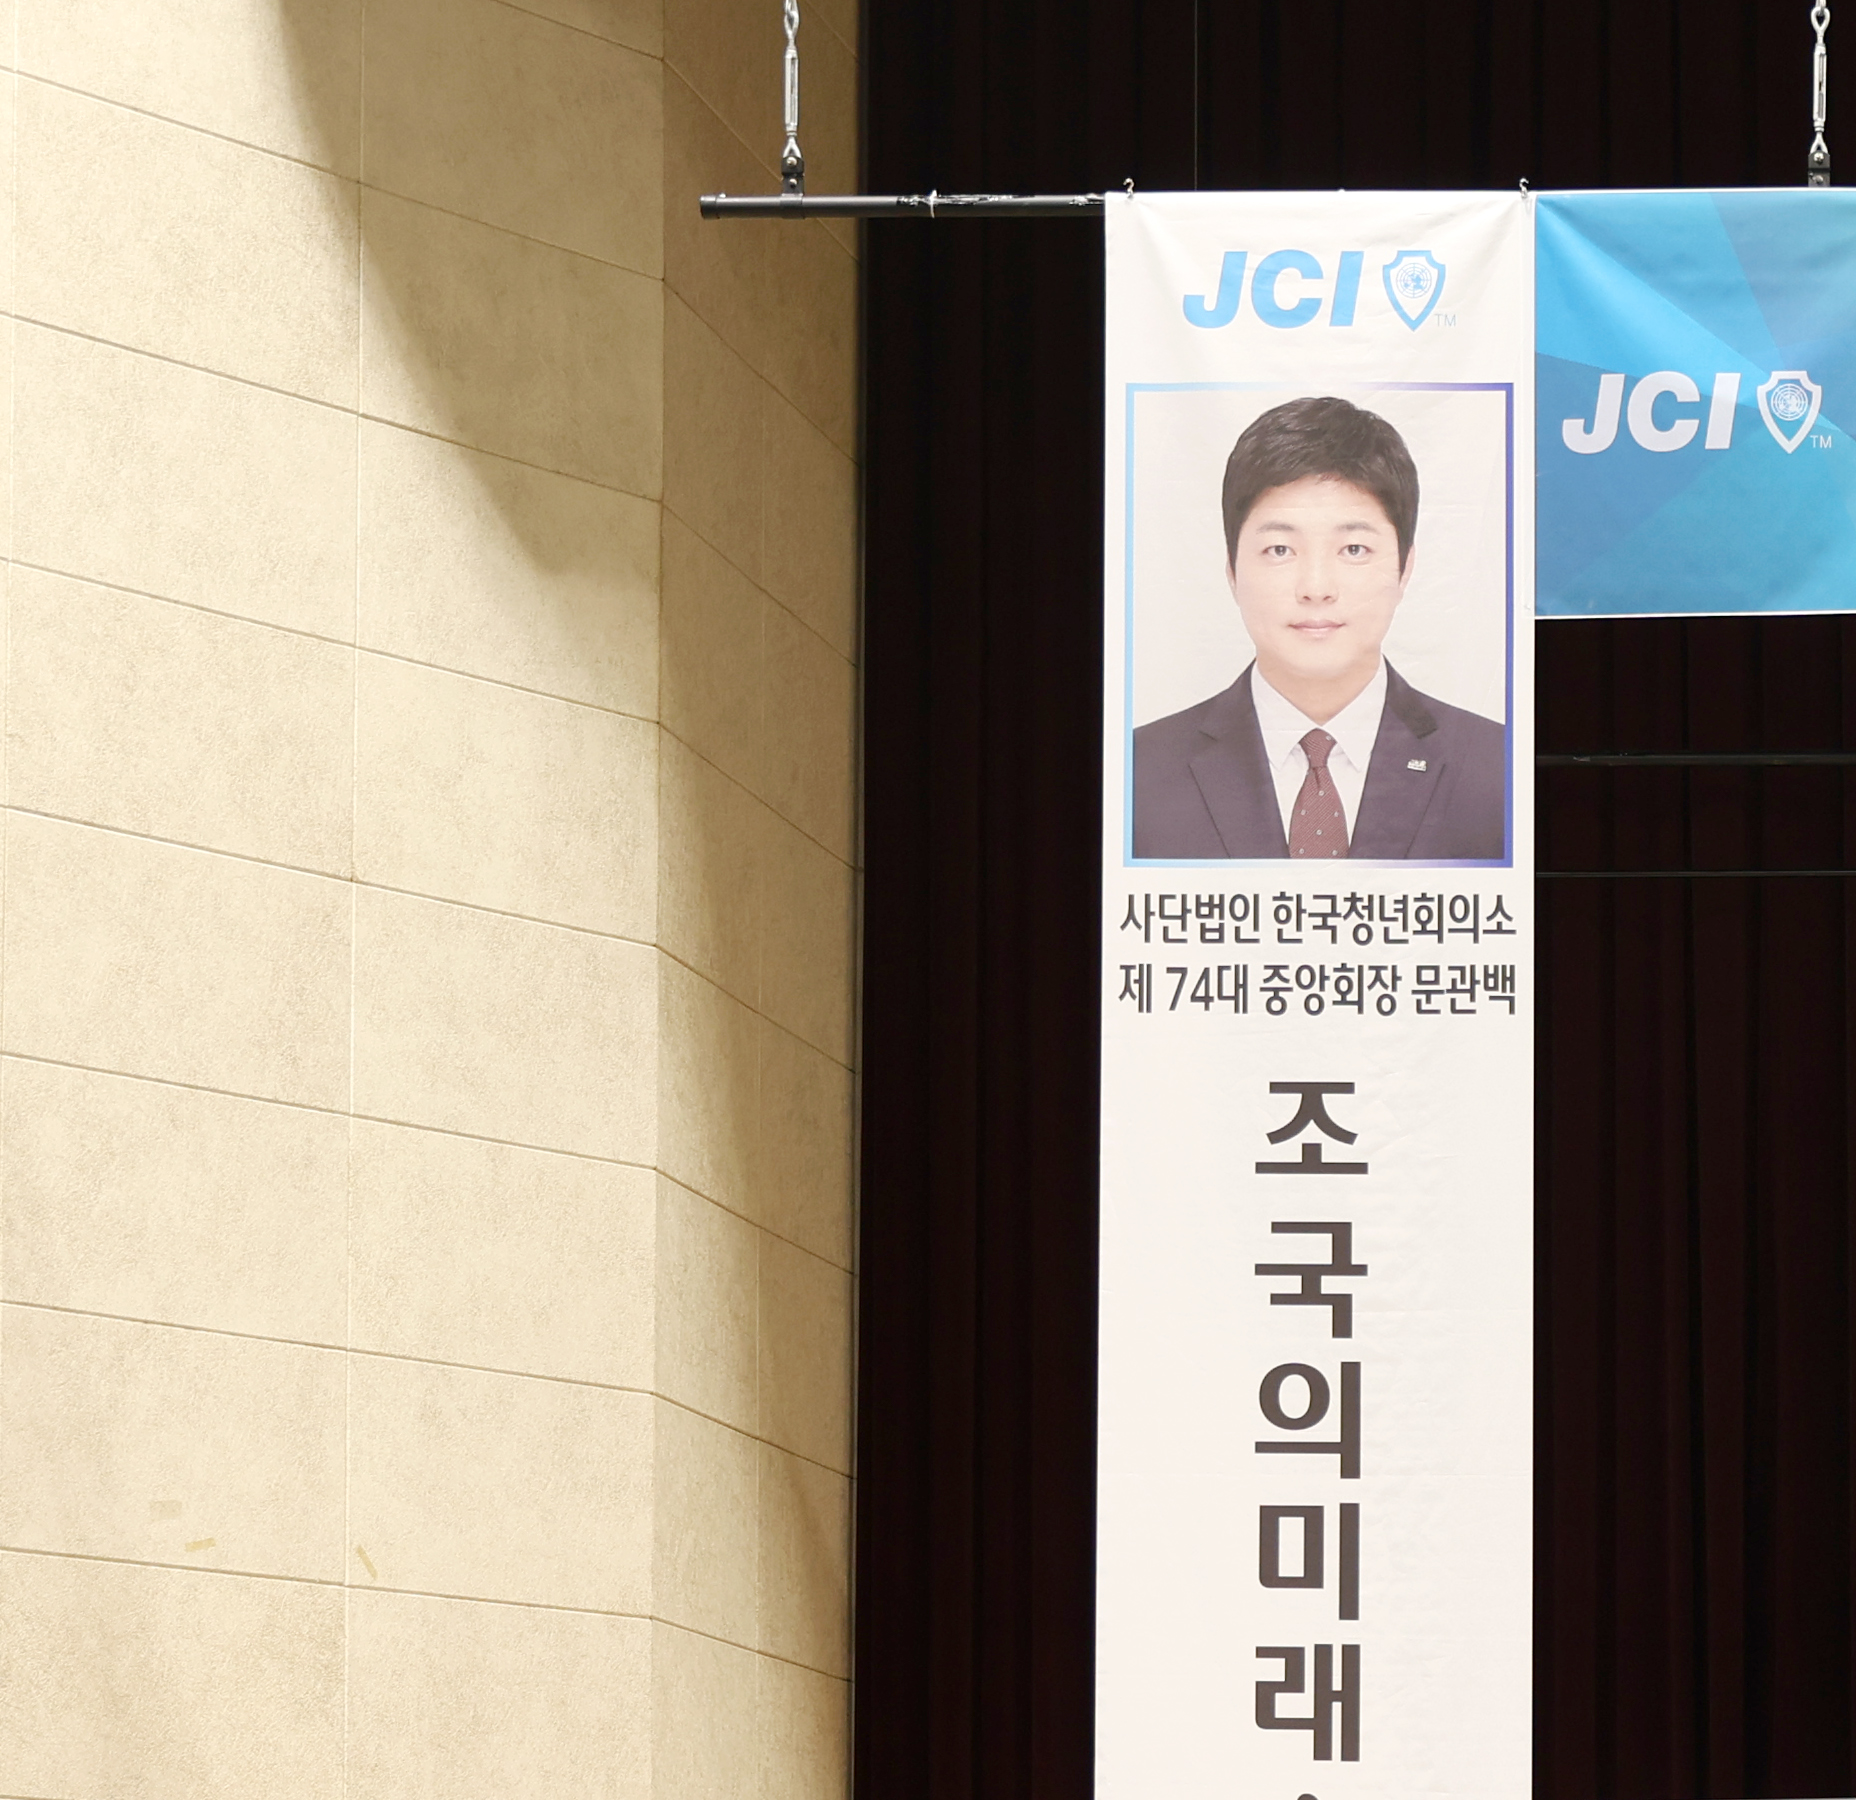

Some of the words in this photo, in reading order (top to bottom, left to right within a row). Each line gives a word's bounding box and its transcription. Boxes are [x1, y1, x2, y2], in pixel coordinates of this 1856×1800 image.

[1182, 249, 1363, 329] JCI
[1434, 313, 1457, 327] TM
[1563, 371, 1738, 454] JCI
[1809, 435, 1833, 449] TM
[1119, 890, 1262, 946] 사단법인
[1271, 888, 1518, 945] 한국청년회의소
[1118, 962, 1154, 1016] 제
[1165, 962, 1250, 1016] 74대
[1259, 961, 1403, 1018] 중앙회장
[1410, 962, 1517, 1017] 문관백
